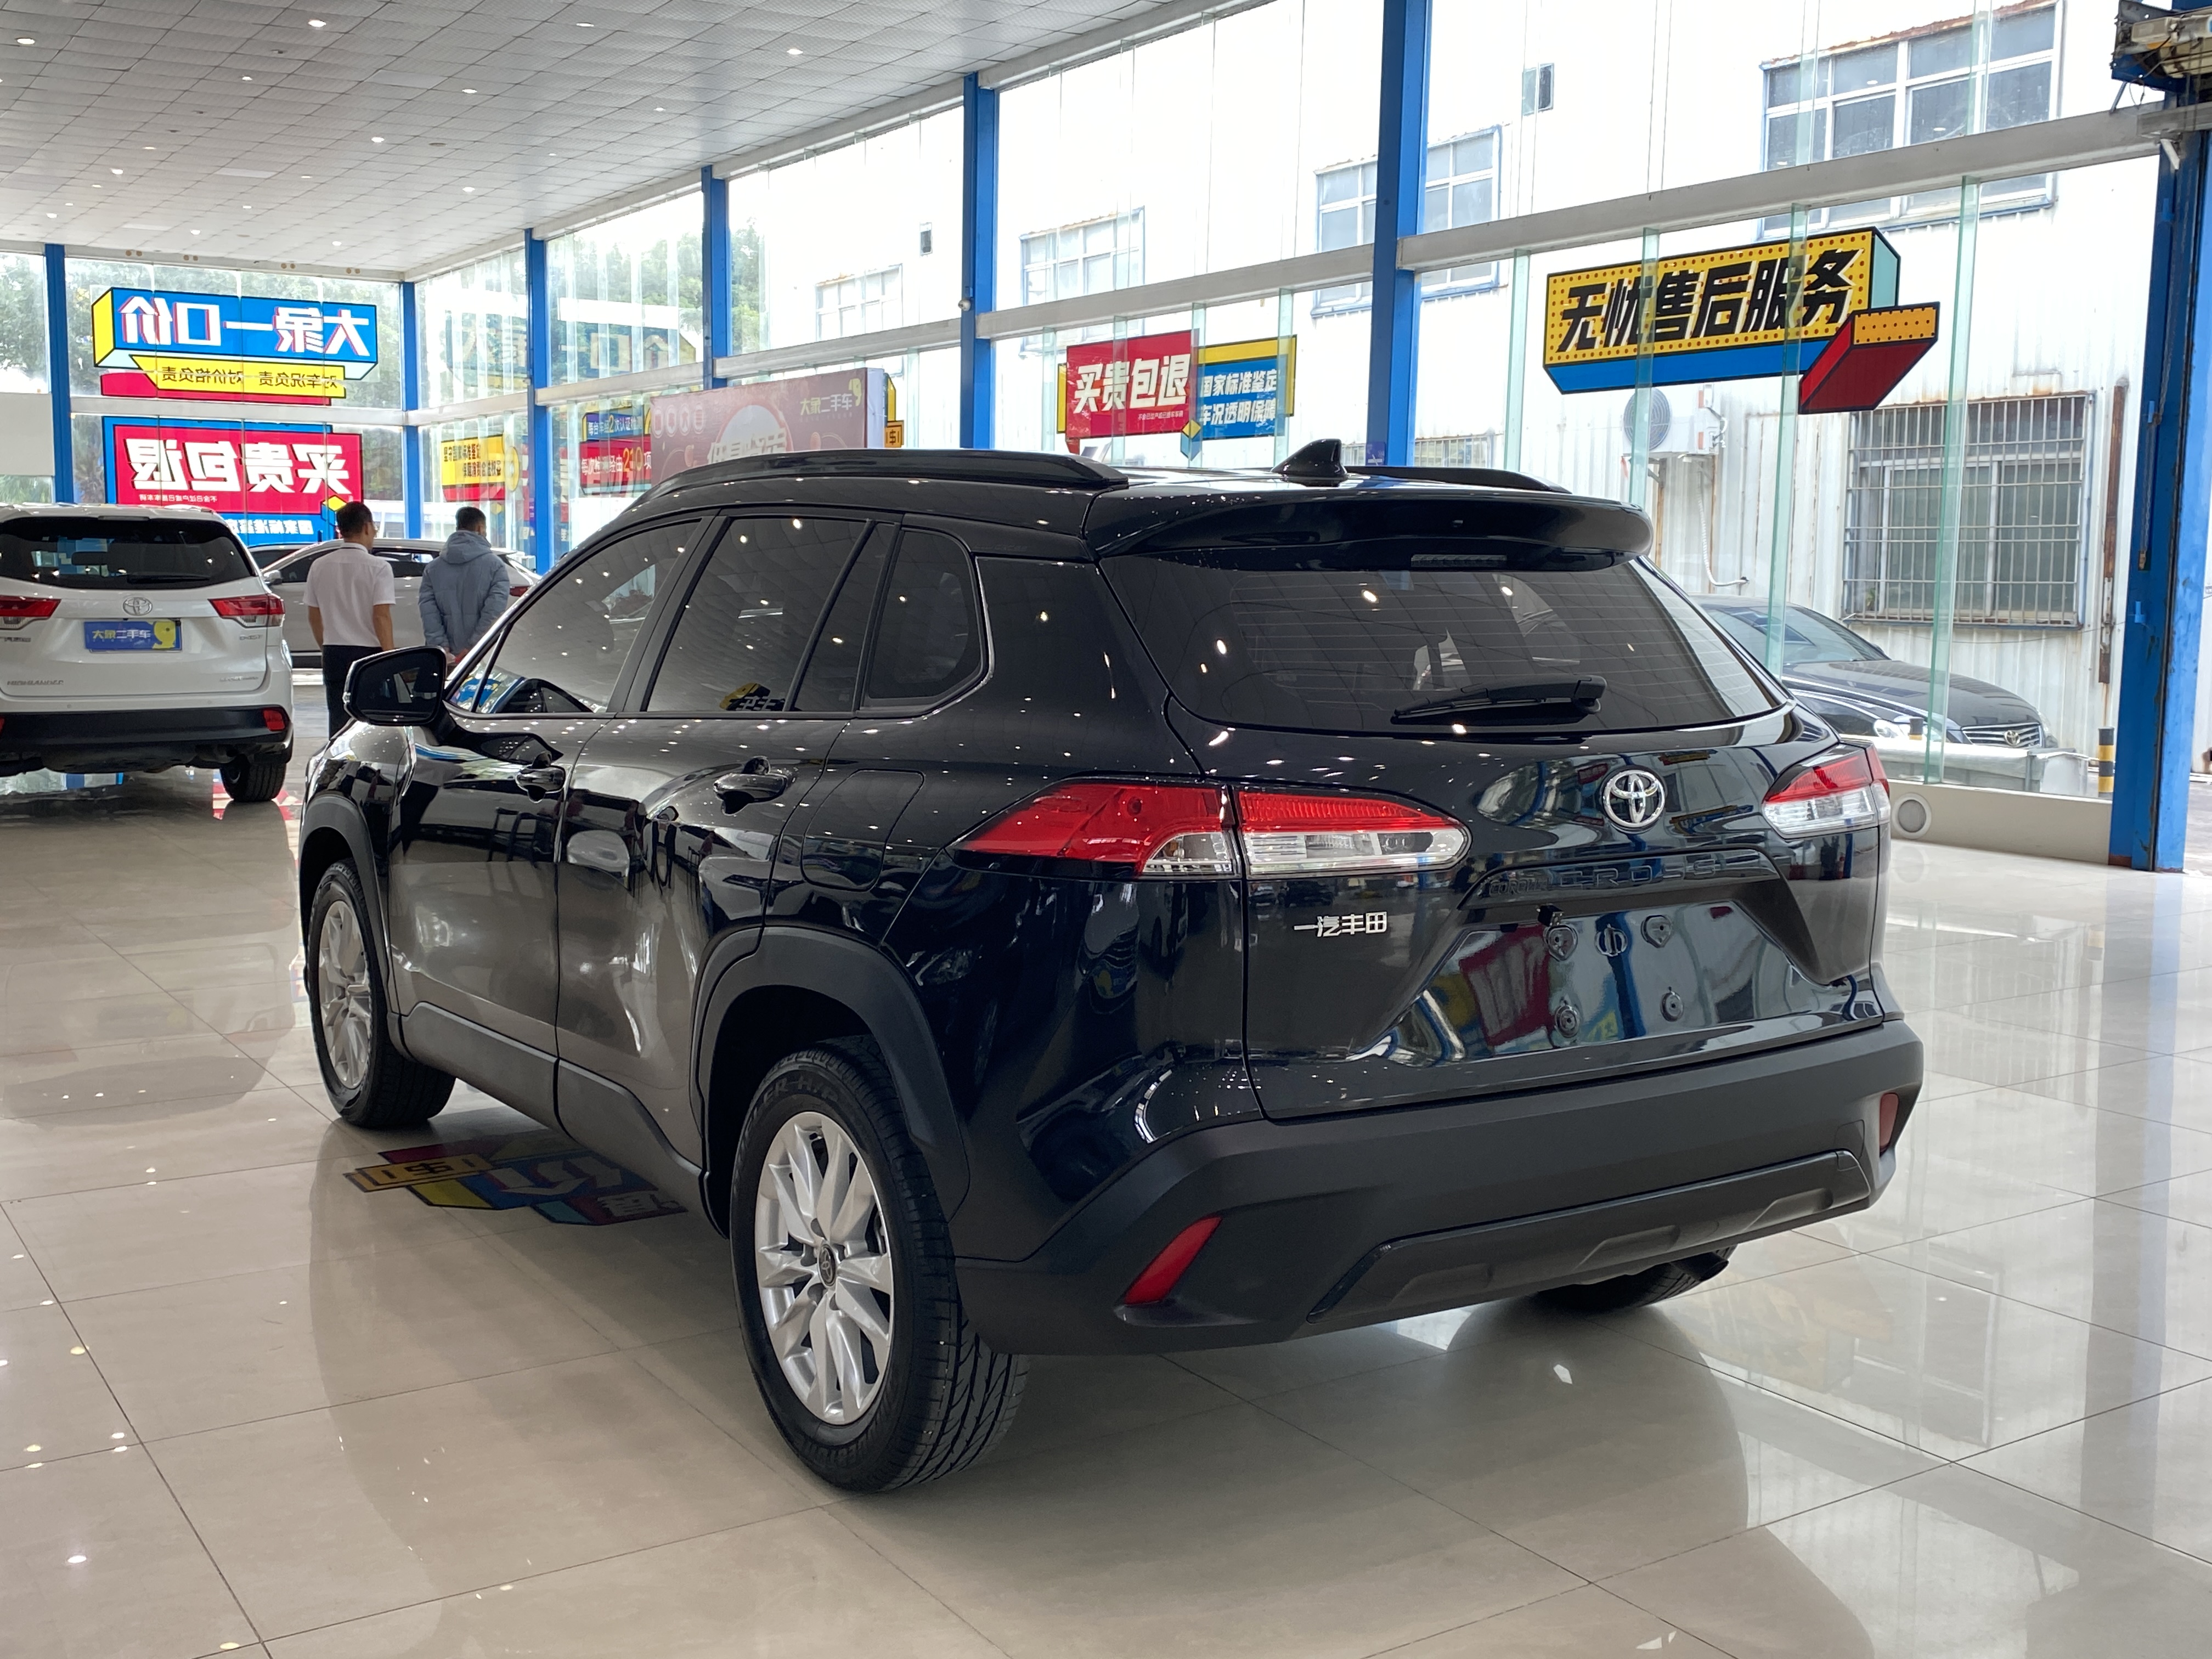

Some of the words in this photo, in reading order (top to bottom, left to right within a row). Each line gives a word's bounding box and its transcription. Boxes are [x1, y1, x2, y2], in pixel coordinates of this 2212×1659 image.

[1558, 249, 1862, 352] 无忧售后服务
[1073, 354, 1191, 414] 买贵包退
[1201, 369, 1277, 397] 国家标准鉴定
[799, 393, 853, 416] 大象二手车
[1200, 398, 1276, 426] 车况透明保障
[92, 629, 151, 639] 大象二手车
[1559, 859, 1717, 888] CROSS
[1293, 911, 1387, 938] 一汽丰田
